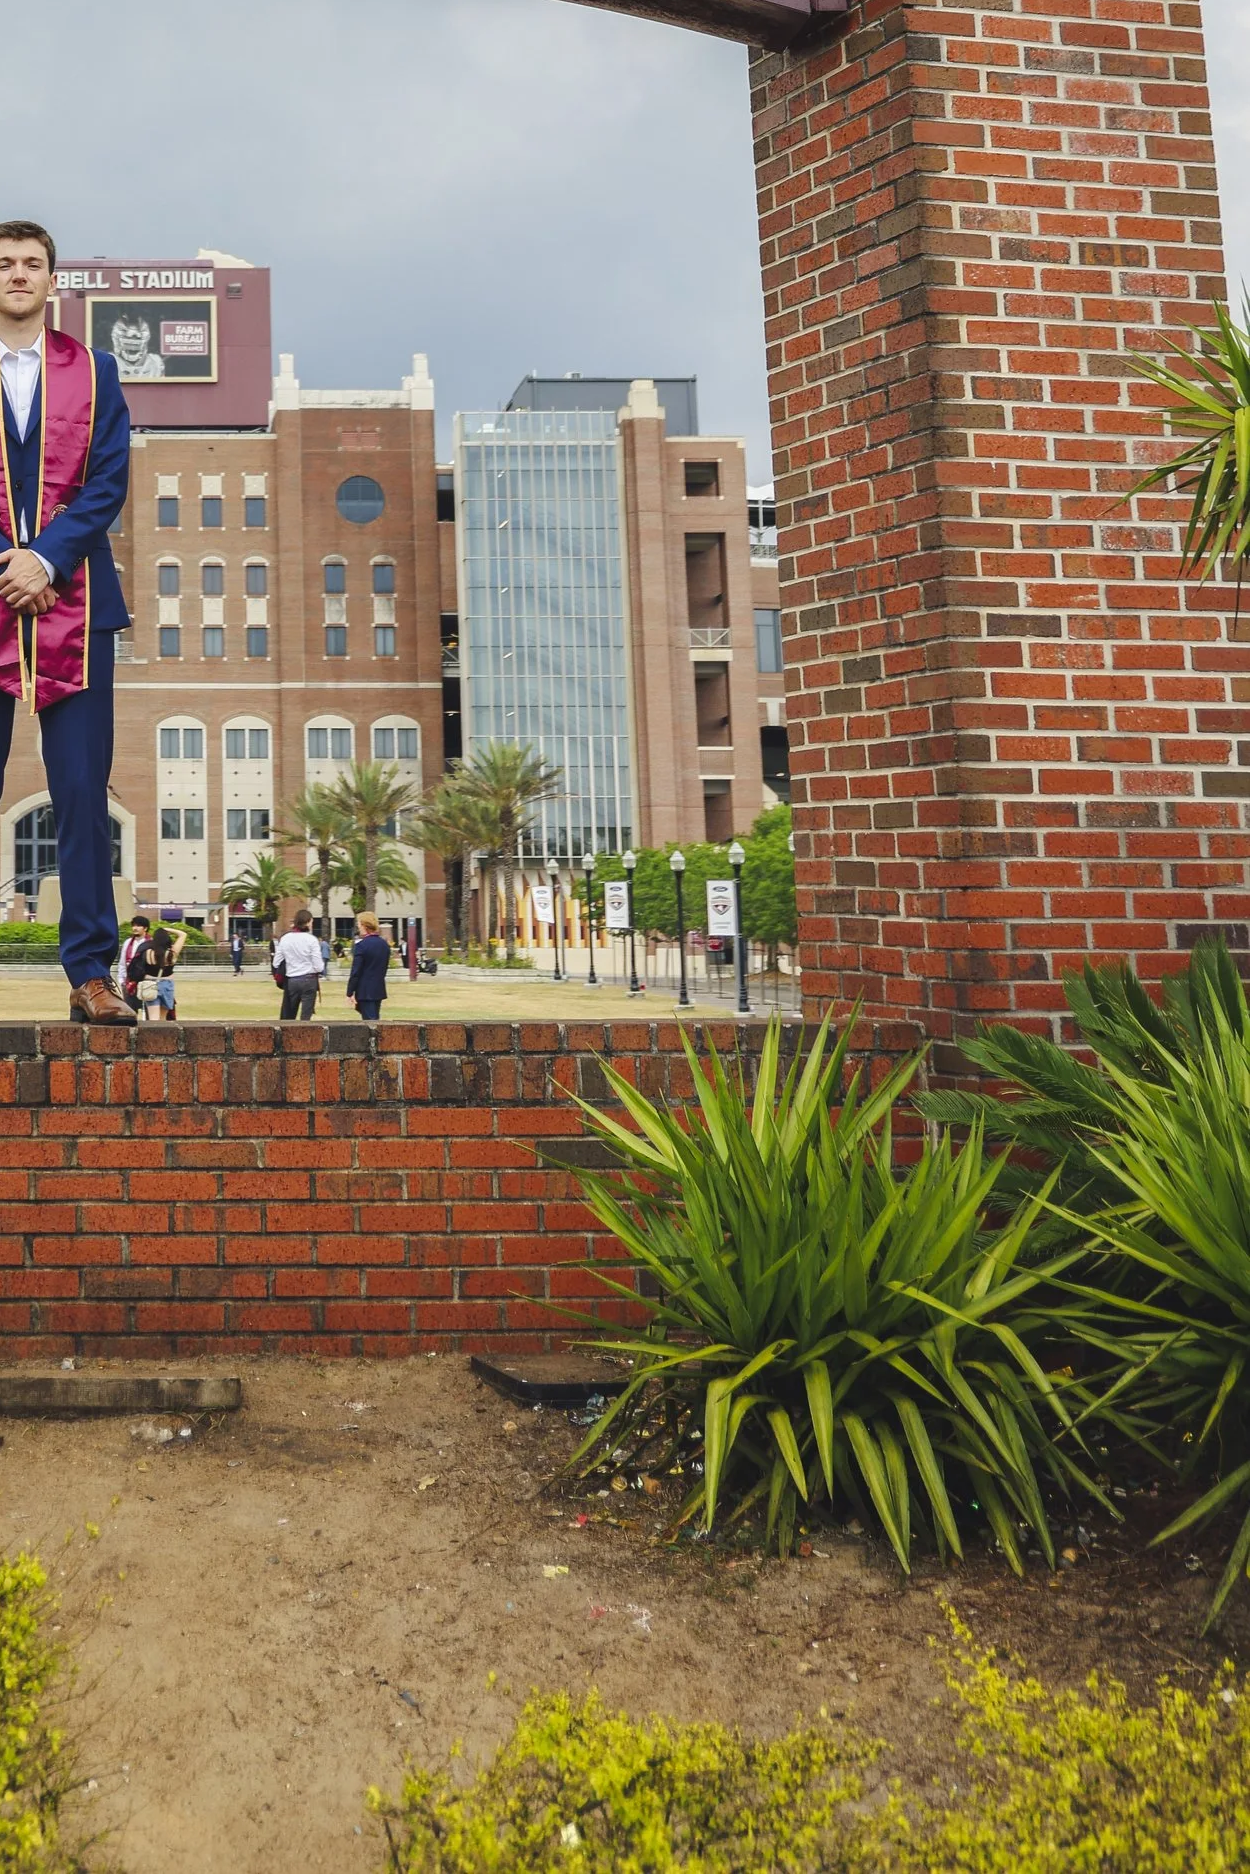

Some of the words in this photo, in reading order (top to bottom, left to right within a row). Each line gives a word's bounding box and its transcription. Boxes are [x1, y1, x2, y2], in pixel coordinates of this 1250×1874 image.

[56, 271, 110, 289] BELL
[120, 271, 214, 289] STADIUM
[176, 325, 203, 335] FARM
[165, 334, 203, 343] BUREAU
